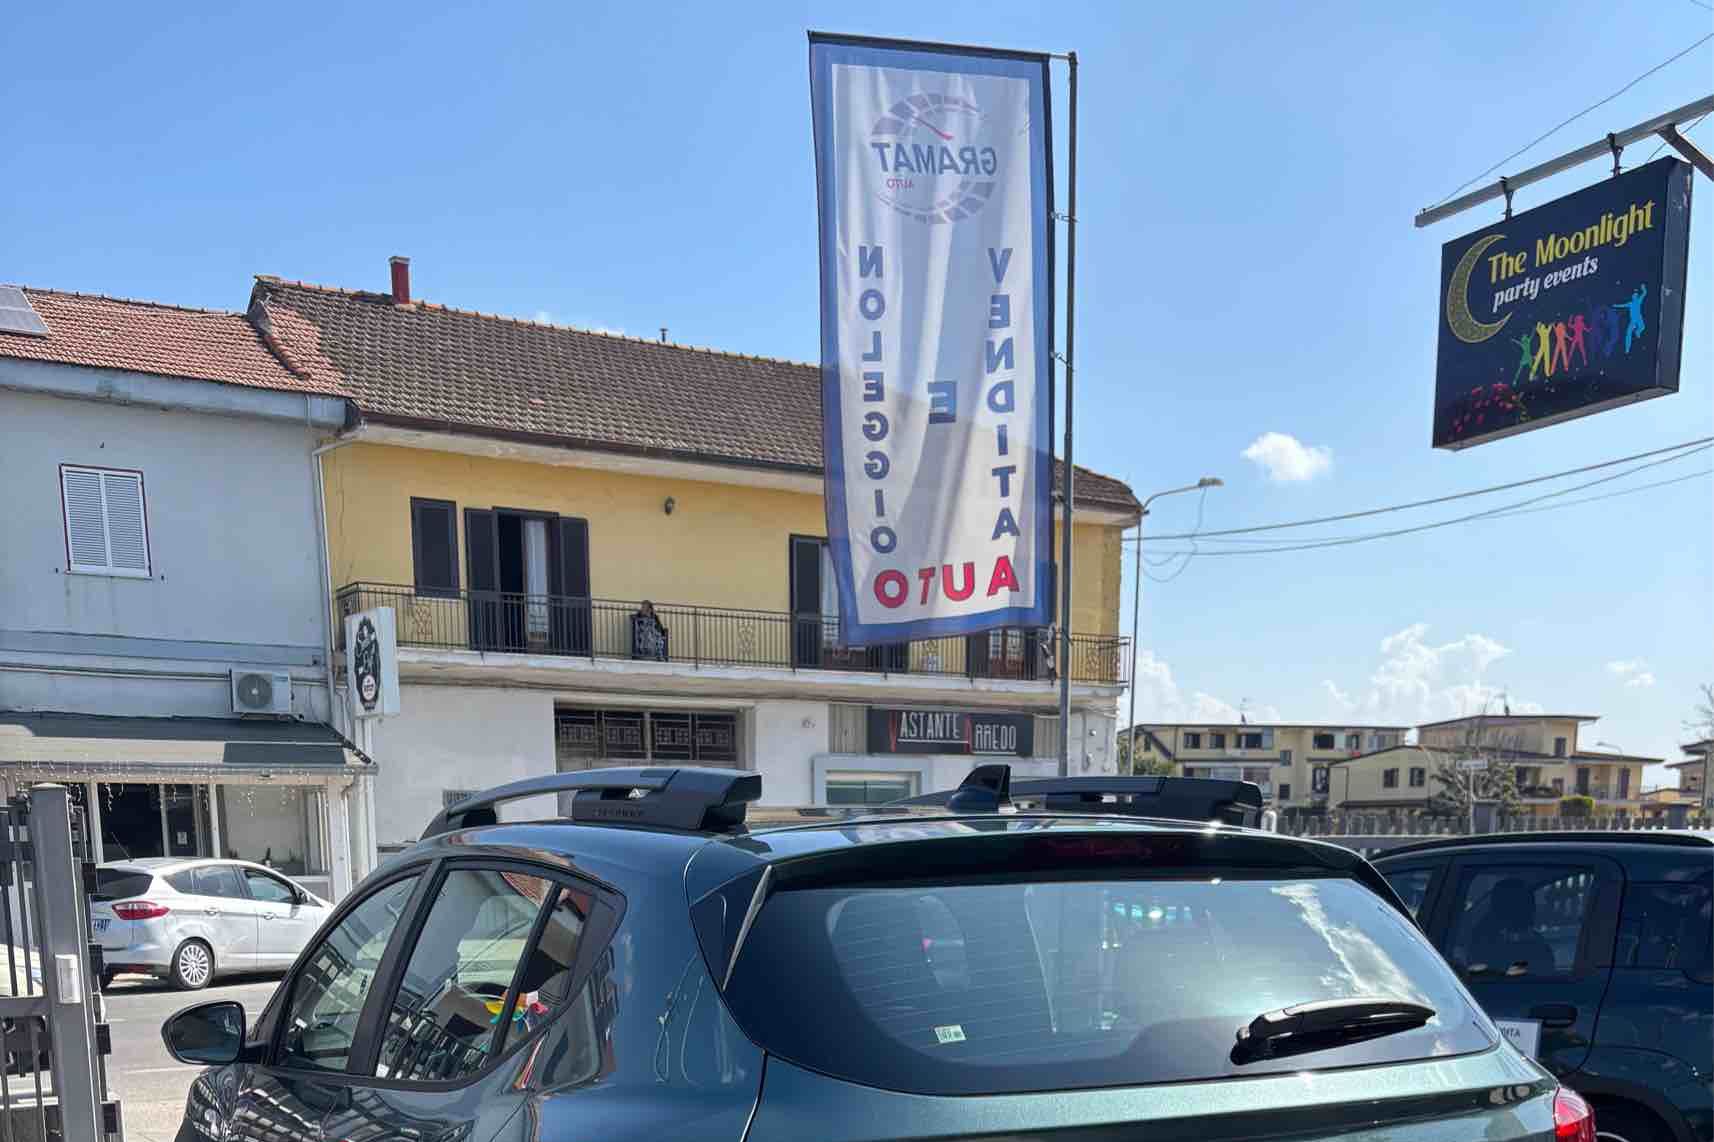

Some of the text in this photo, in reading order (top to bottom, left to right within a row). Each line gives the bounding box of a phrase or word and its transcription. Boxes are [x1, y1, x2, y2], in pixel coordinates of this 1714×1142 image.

[1487, 199, 1656, 284] The Moonlight
[1492, 256, 1599, 312] party events
